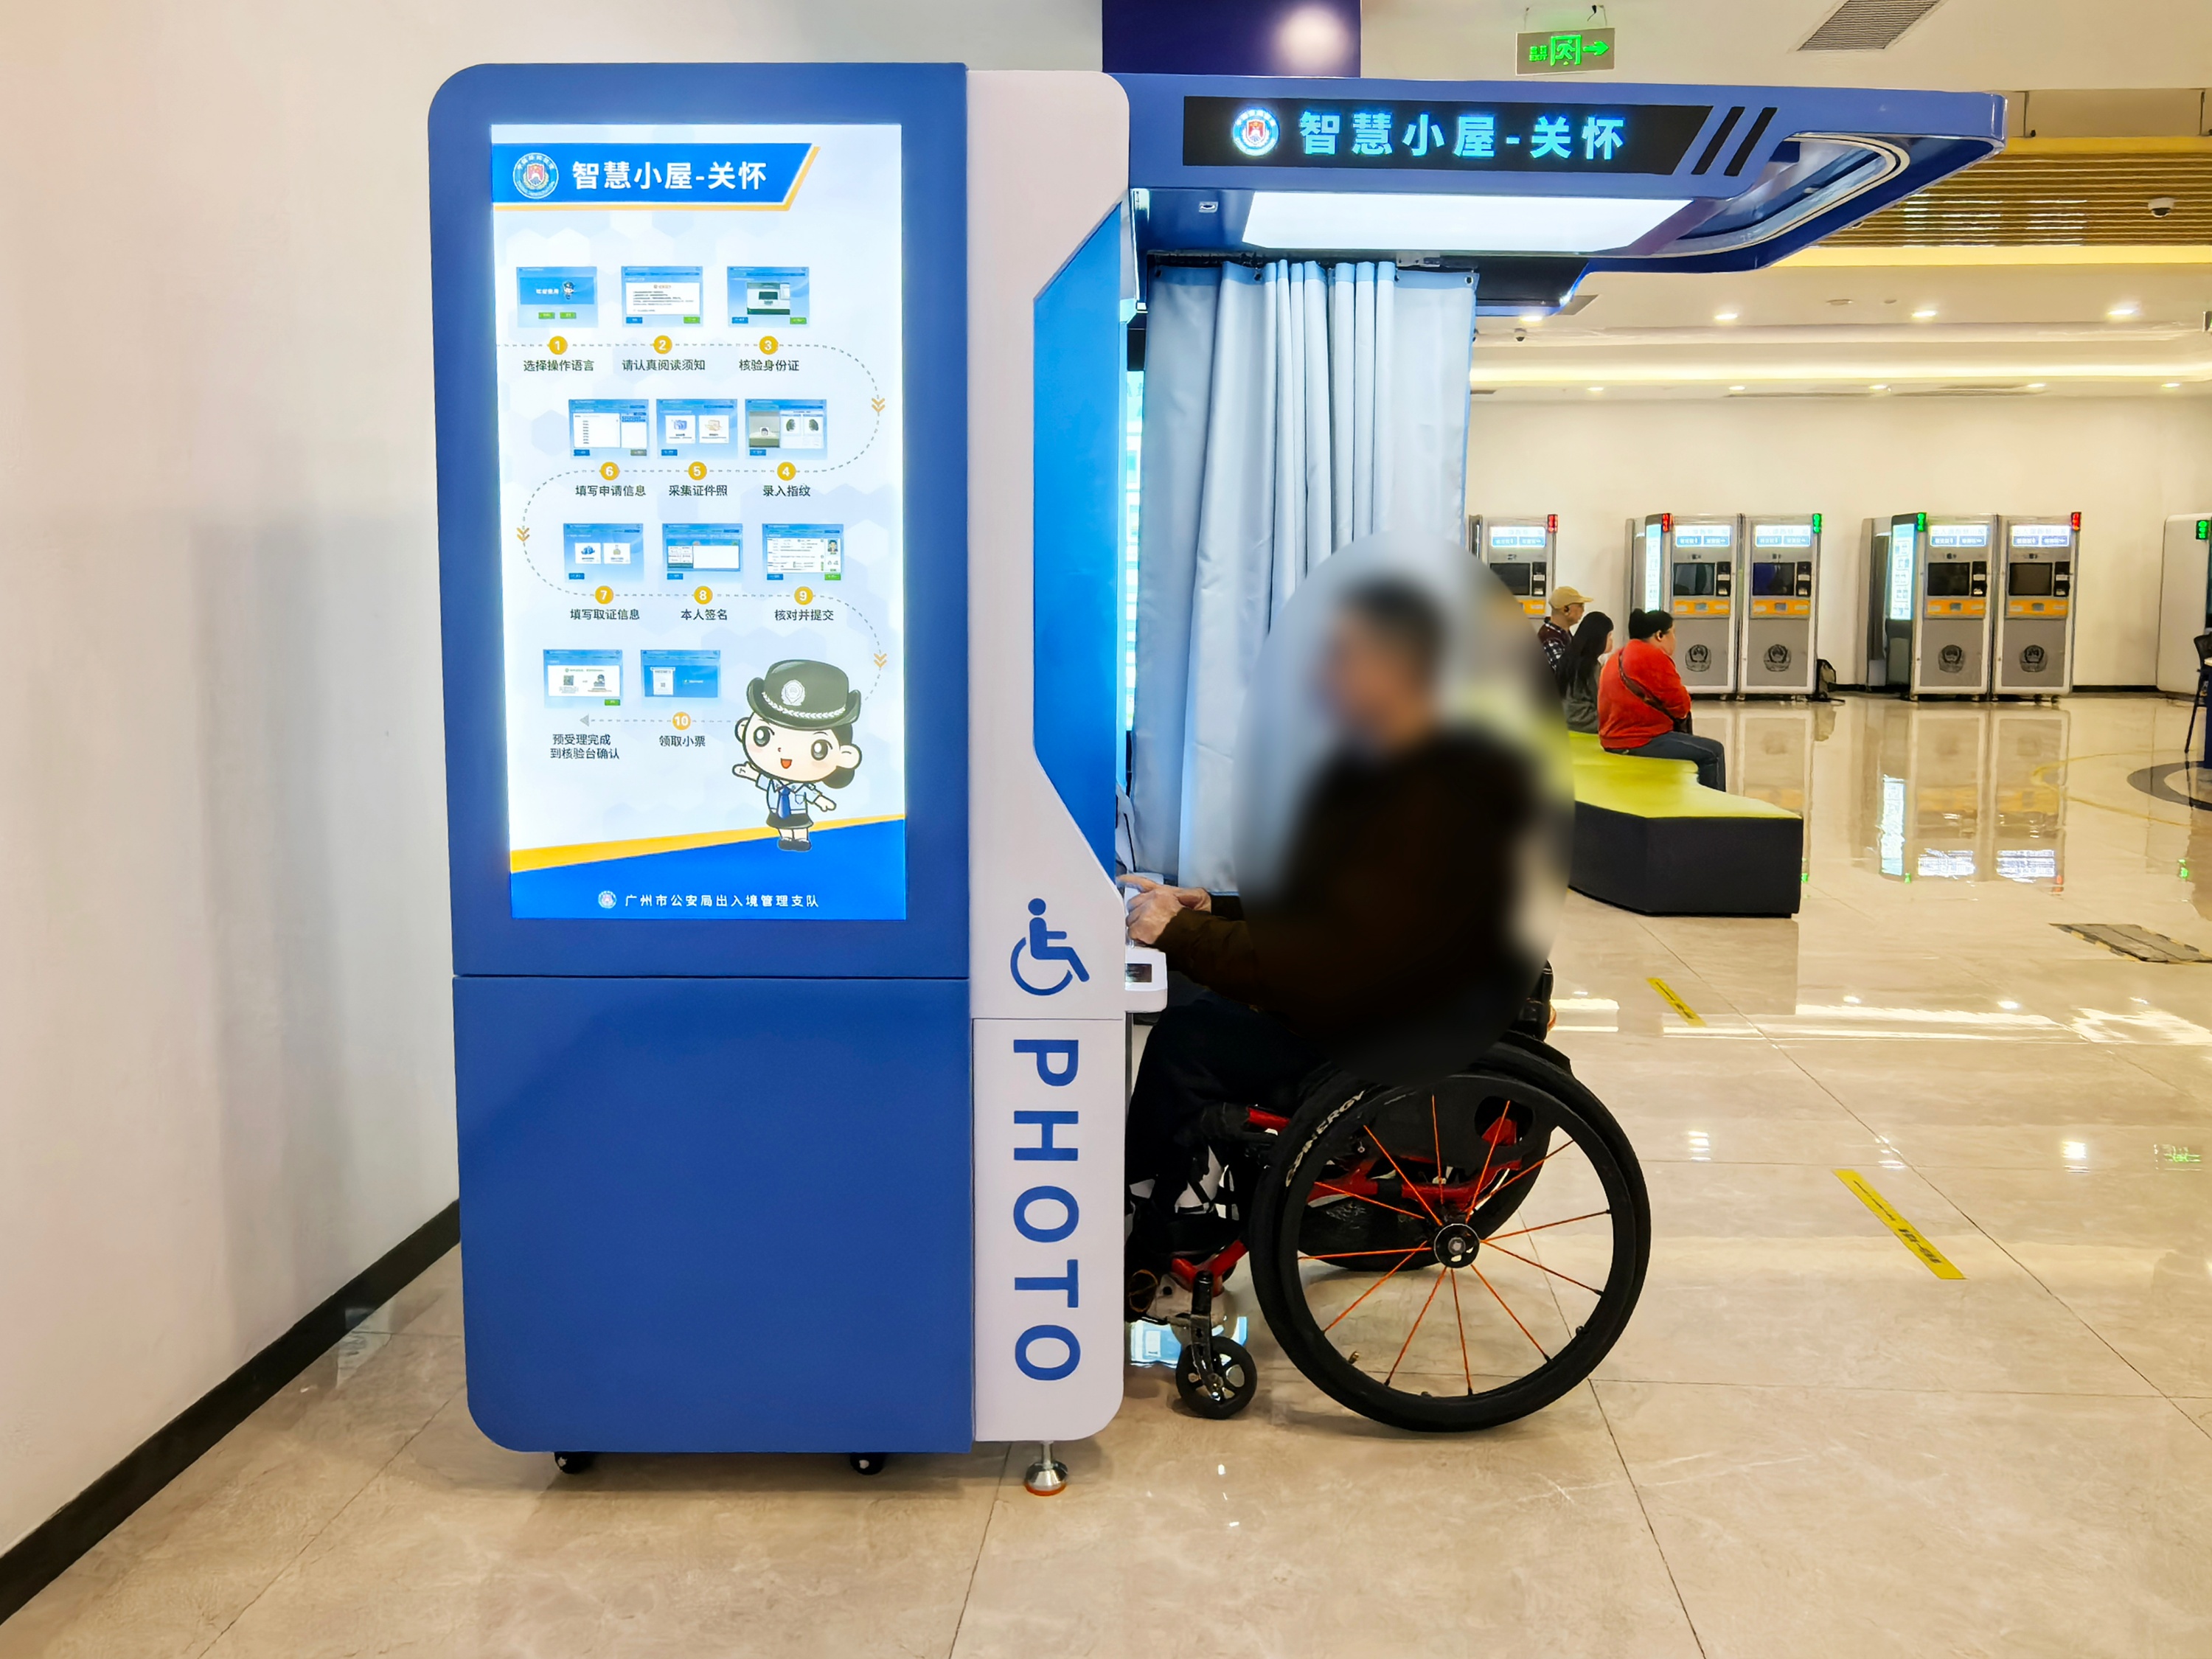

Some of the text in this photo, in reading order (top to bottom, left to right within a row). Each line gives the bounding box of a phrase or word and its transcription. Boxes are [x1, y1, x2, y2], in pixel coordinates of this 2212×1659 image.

[1298, 111, 1624, 160] 智慧小屋-关怀
[572, 161, 767, 189] 智慧小屋-关怀
[554, 340, 560, 351] 1
[658, 340, 667, 351] 2
[764, 340, 773, 351] 3
[524, 360, 594, 372] 选择操作语言
[622, 359, 706, 372] 请认真阅读须知
[739, 359, 799, 372] 核验身份证
[605, 466, 614, 476] 6
[693, 466, 701, 476] 5
[782, 466, 790, 476] 4
[575, 485, 647, 497] 填写申请信息
[669, 484, 728, 496] 采集证件照
[763, 484, 811, 497] 录入指纹
[600, 590, 608, 600] 7
[698, 590, 708, 600] 8
[799, 590, 808, 601] 9
[570, 608, 640, 621] 填写取证信息
[681, 608, 728, 621] 本人签名
[774, 608, 835, 621] 核对并提交
[674, 715, 689, 726] 10
[552, 734, 611, 745] 预受理完成
[659, 735, 706, 747] 领取小票
[550, 747, 619, 759] 到核验台确认
[625, 894, 819, 908] 广州市公安局出入境管理支队
[1013, 1039, 1081, 1381] PHOTO
